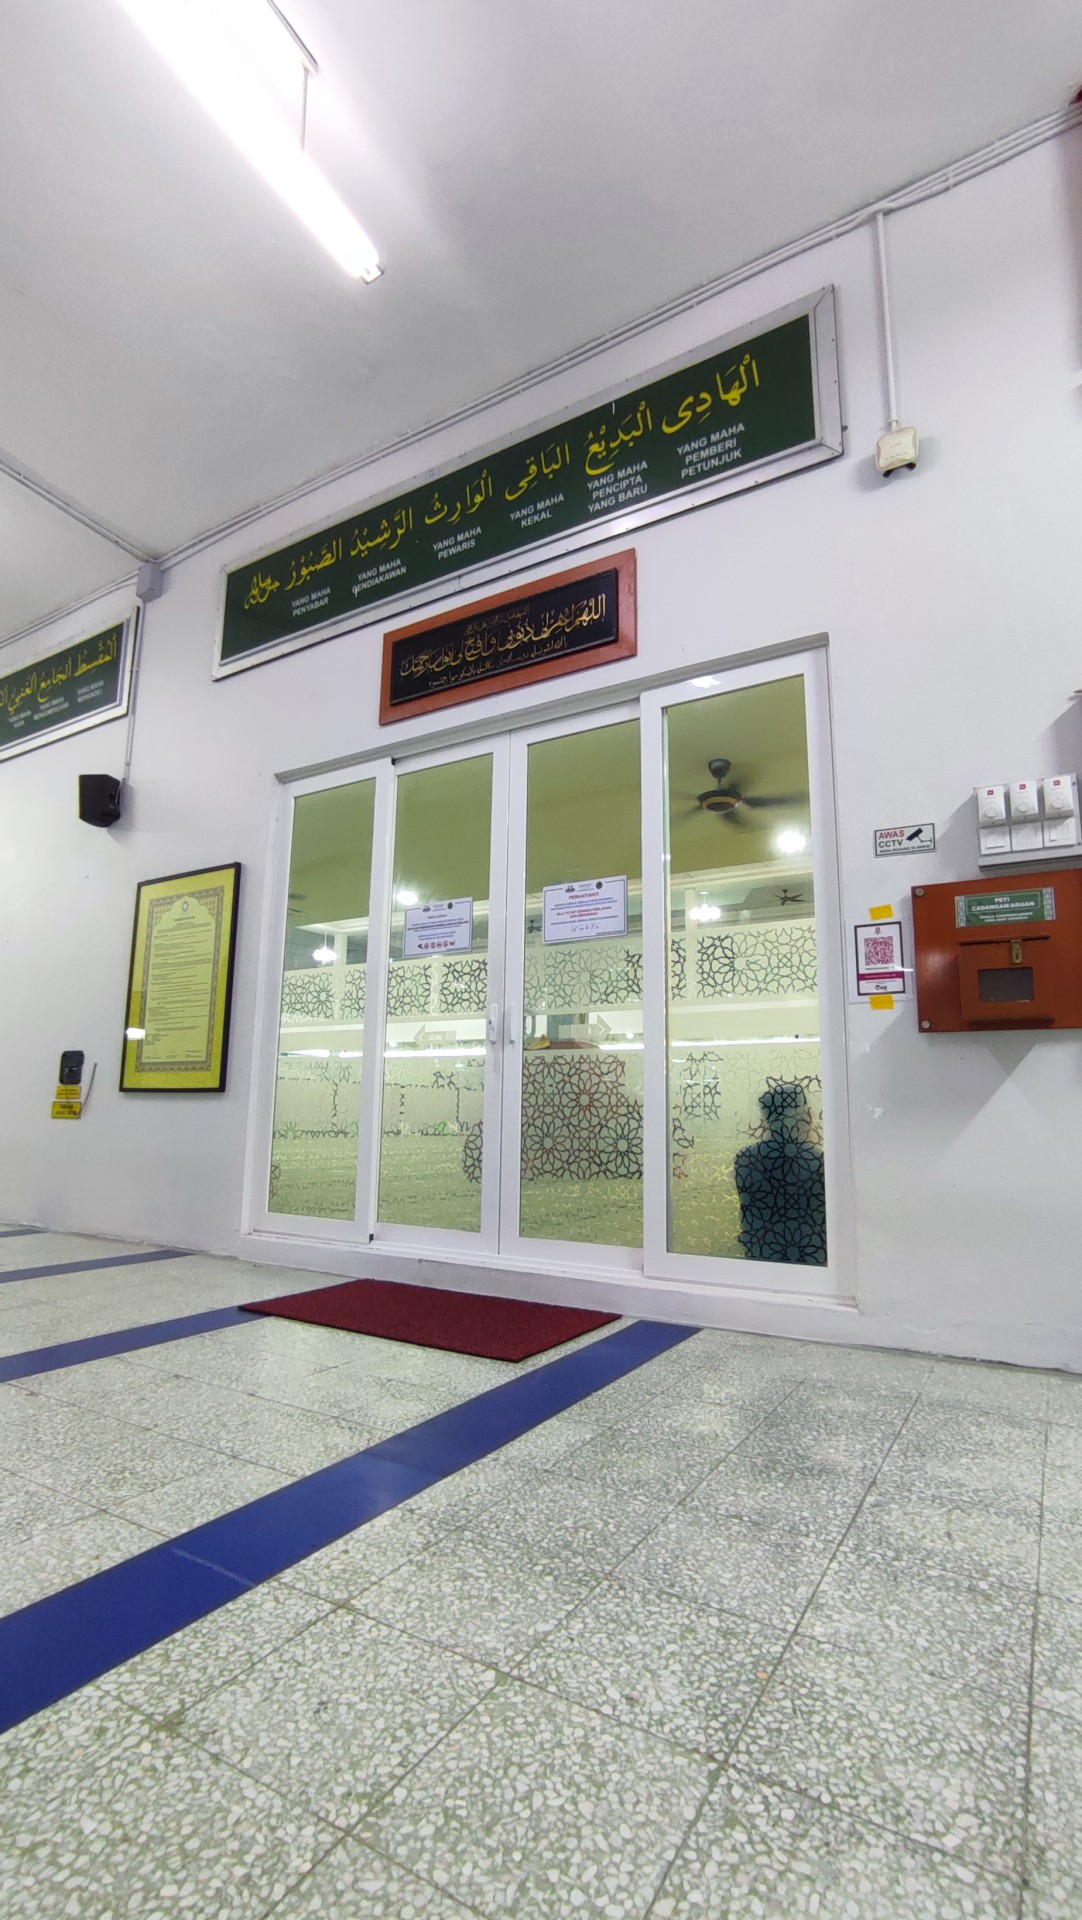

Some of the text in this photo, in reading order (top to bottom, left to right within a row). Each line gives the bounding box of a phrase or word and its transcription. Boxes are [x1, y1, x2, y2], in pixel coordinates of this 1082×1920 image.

[677, 422, 745, 456] YANG MAHA
[685, 438, 737, 464] PEMBERI
[587, 460, 648, 490] YANG MAHA
[681, 448, 742, 479] PETUNJUK
[588, 484, 648, 514] YANG BARU
[592, 475, 642, 500] PENCIPTA
[510, 493, 564, 522] YANG MAHA
[521, 511, 552, 528] KEKAL
[432, 526, 482, 552] YANG MAHA
[438, 539, 476, 560] PEWARIS
[357, 558, 401, 582] YANG MAHA
[291, 586, 331, 608] YANG MAHA
[292, 597, 329, 617] PENYABAR
[878, 839, 903, 848] CCTV
[879, 829, 905, 840] AWAS
